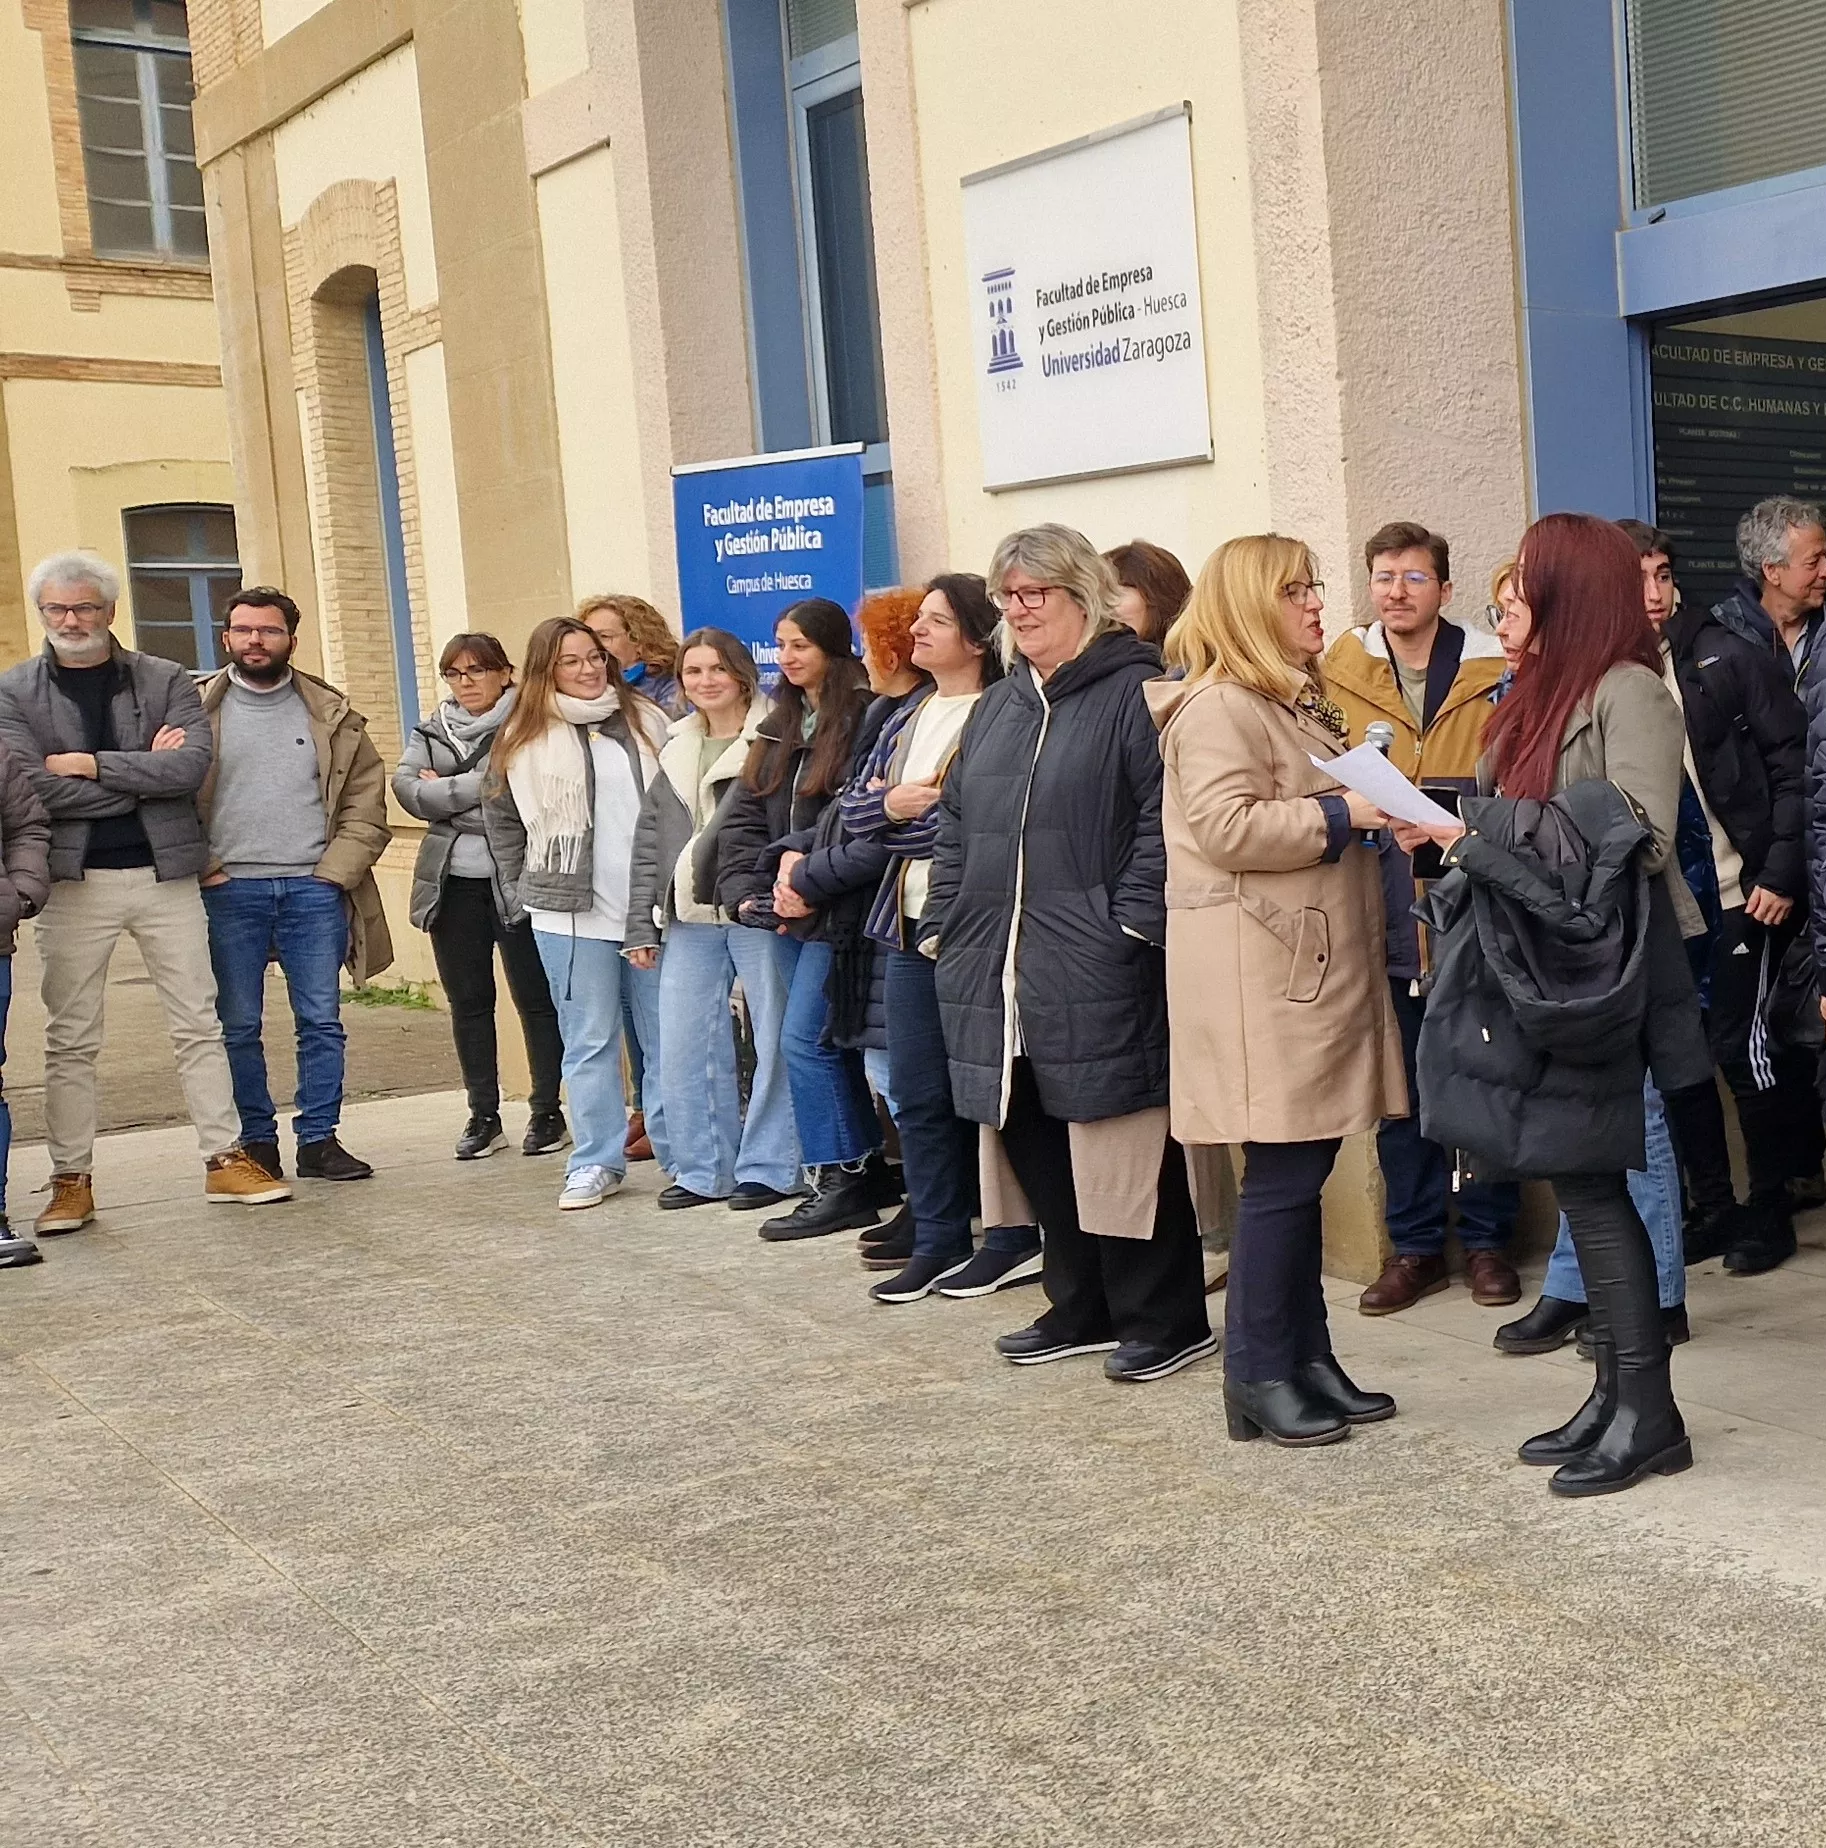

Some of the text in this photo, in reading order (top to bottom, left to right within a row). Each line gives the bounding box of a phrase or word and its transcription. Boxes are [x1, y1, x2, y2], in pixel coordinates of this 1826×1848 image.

[1036, 265, 1154, 308] Facultad de Empresa
[1038, 323, 1046, 345] y
[1046, 311, 1090, 338] Gestión
[1092, 303, 1136, 330] Pública
[1143, 291, 1188, 317] Huesca
[1041, 330, 1192, 378] Universidad Zaragoza
[1652, 344, 1710, 363] ACULTAD
[1713, 348, 1733, 365] DE
[1734, 350, 1795, 370] EMPRESA
[1797, 356, 1806, 370] Y
[996, 379, 1018, 393] 1542
[1653, 391, 1697, 409] ULTAD
[1699, 394, 1718, 411] DE
[1748, 398, 1811, 417] HUMANAS
[1812, 401, 1821, 416] Y
[703, 495, 836, 528] Facultad de Empresa
[714, 525, 823, 563] y Gestión Pública
[726, 570, 813, 598] Campus de Huesca
[752, 640, 781, 664] Unive
